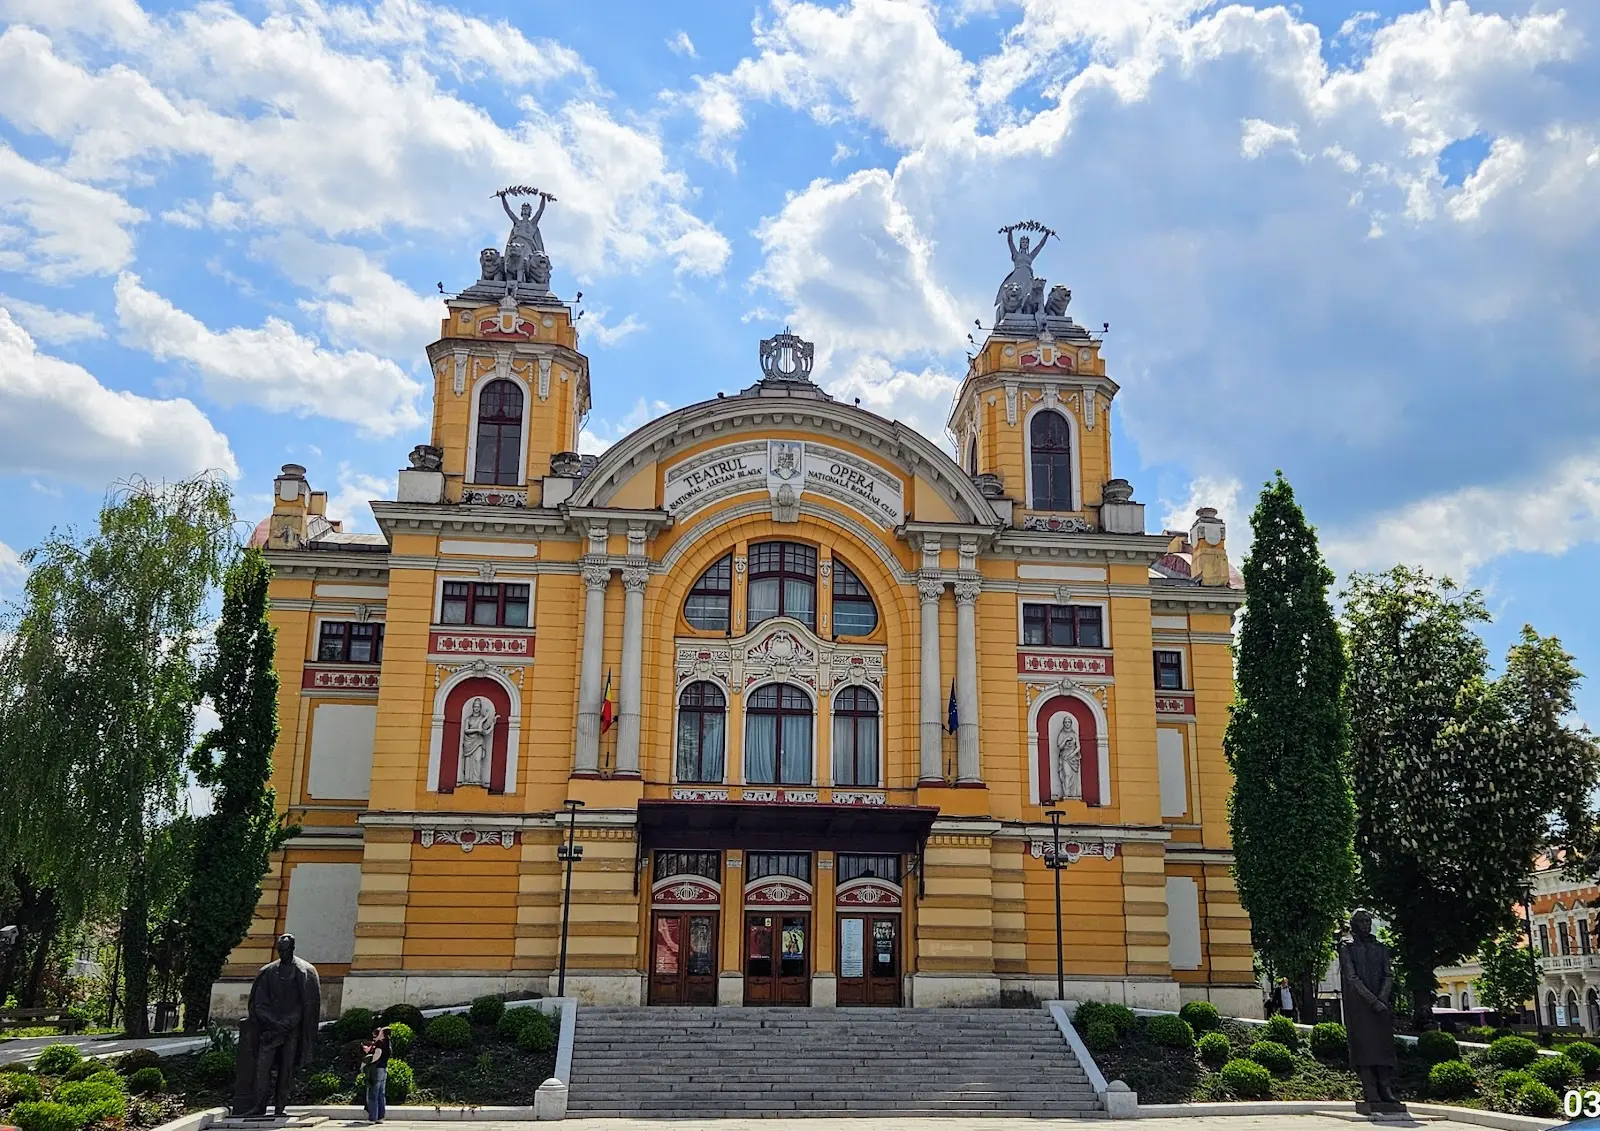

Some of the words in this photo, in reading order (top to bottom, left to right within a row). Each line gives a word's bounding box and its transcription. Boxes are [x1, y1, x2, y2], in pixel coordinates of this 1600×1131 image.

[683, 458, 747, 488] TEATRUL
[830, 464, 874, 492] OPERA
[881, 503, 898, 518] CLUJ
